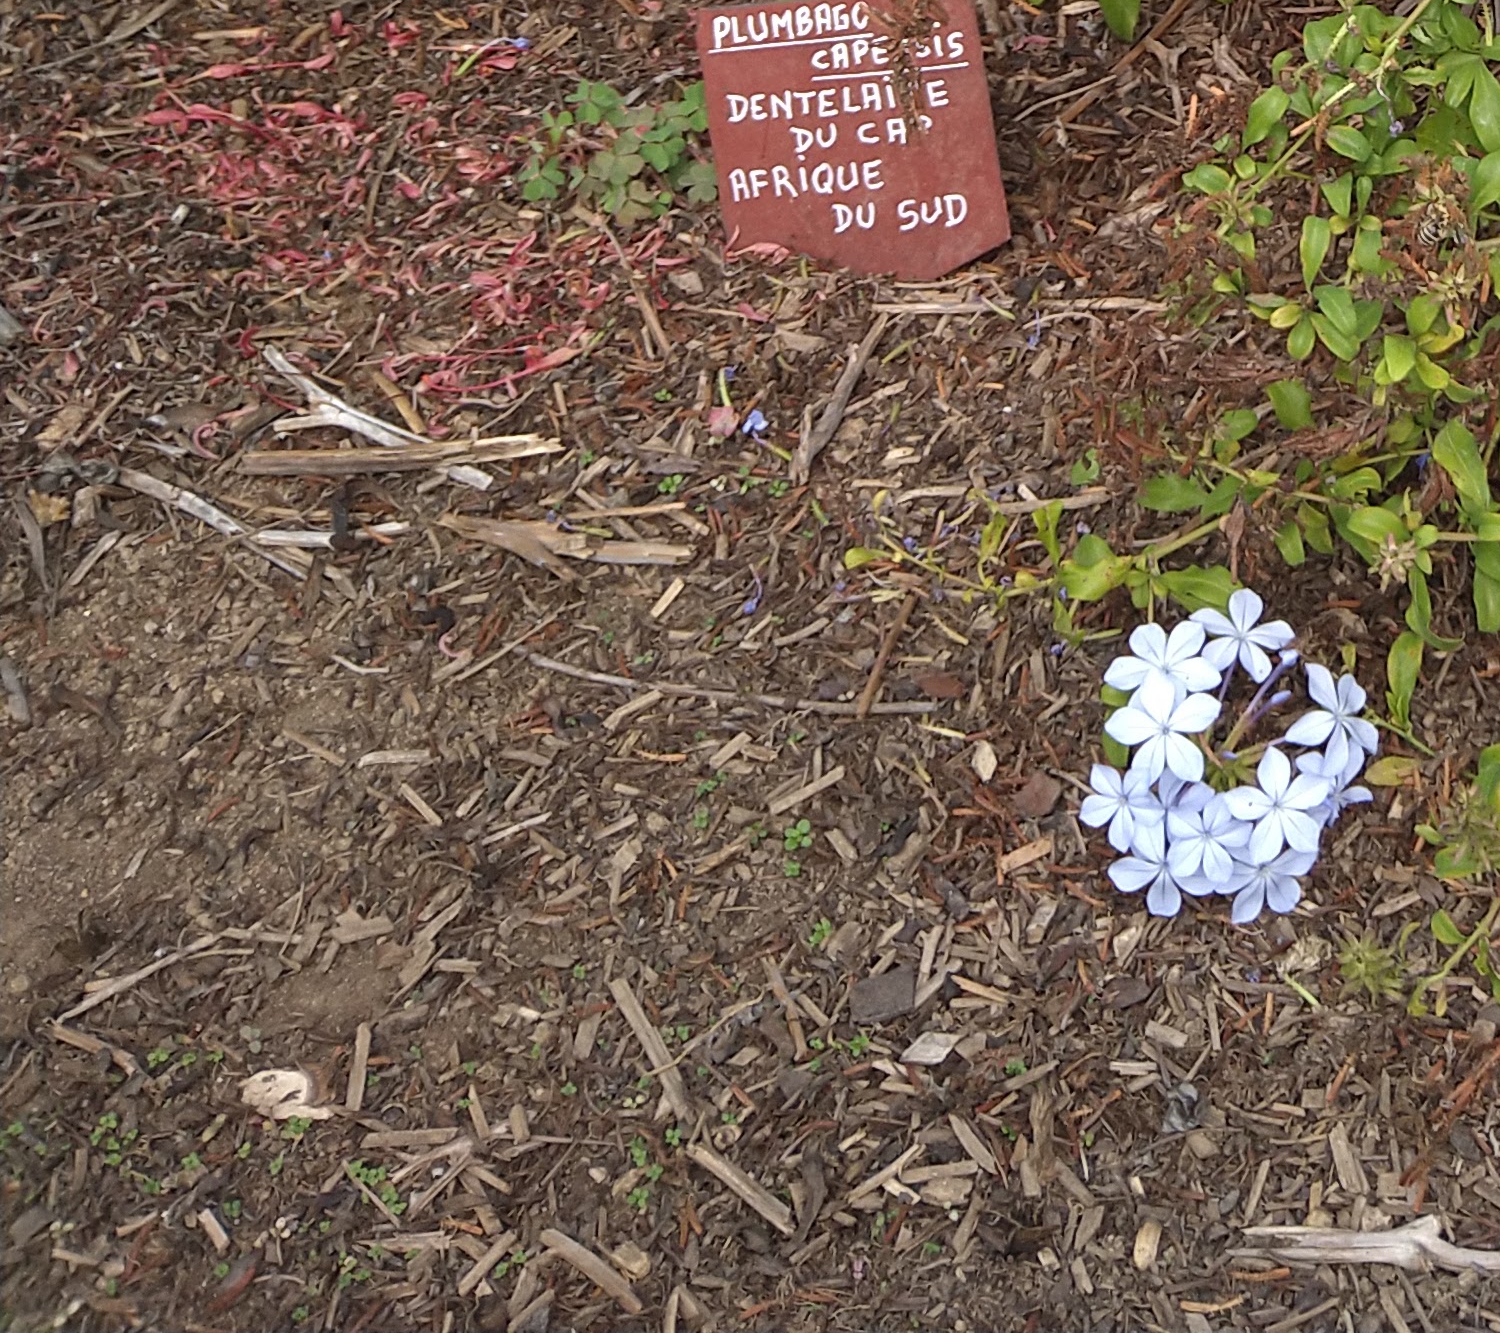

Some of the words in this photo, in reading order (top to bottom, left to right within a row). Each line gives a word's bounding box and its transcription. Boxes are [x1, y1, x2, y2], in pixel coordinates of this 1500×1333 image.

[712, 1, 871, 50] PLUMBAGO
[811, 21, 965, 71] CAPESIS
[725, 76, 950, 124] DENTELAIE
[789, 122, 838, 154] DU
[728, 154, 886, 203] AFRIQUE
[831, 202, 877, 234] DU
[897, 193, 969, 232] SUD
